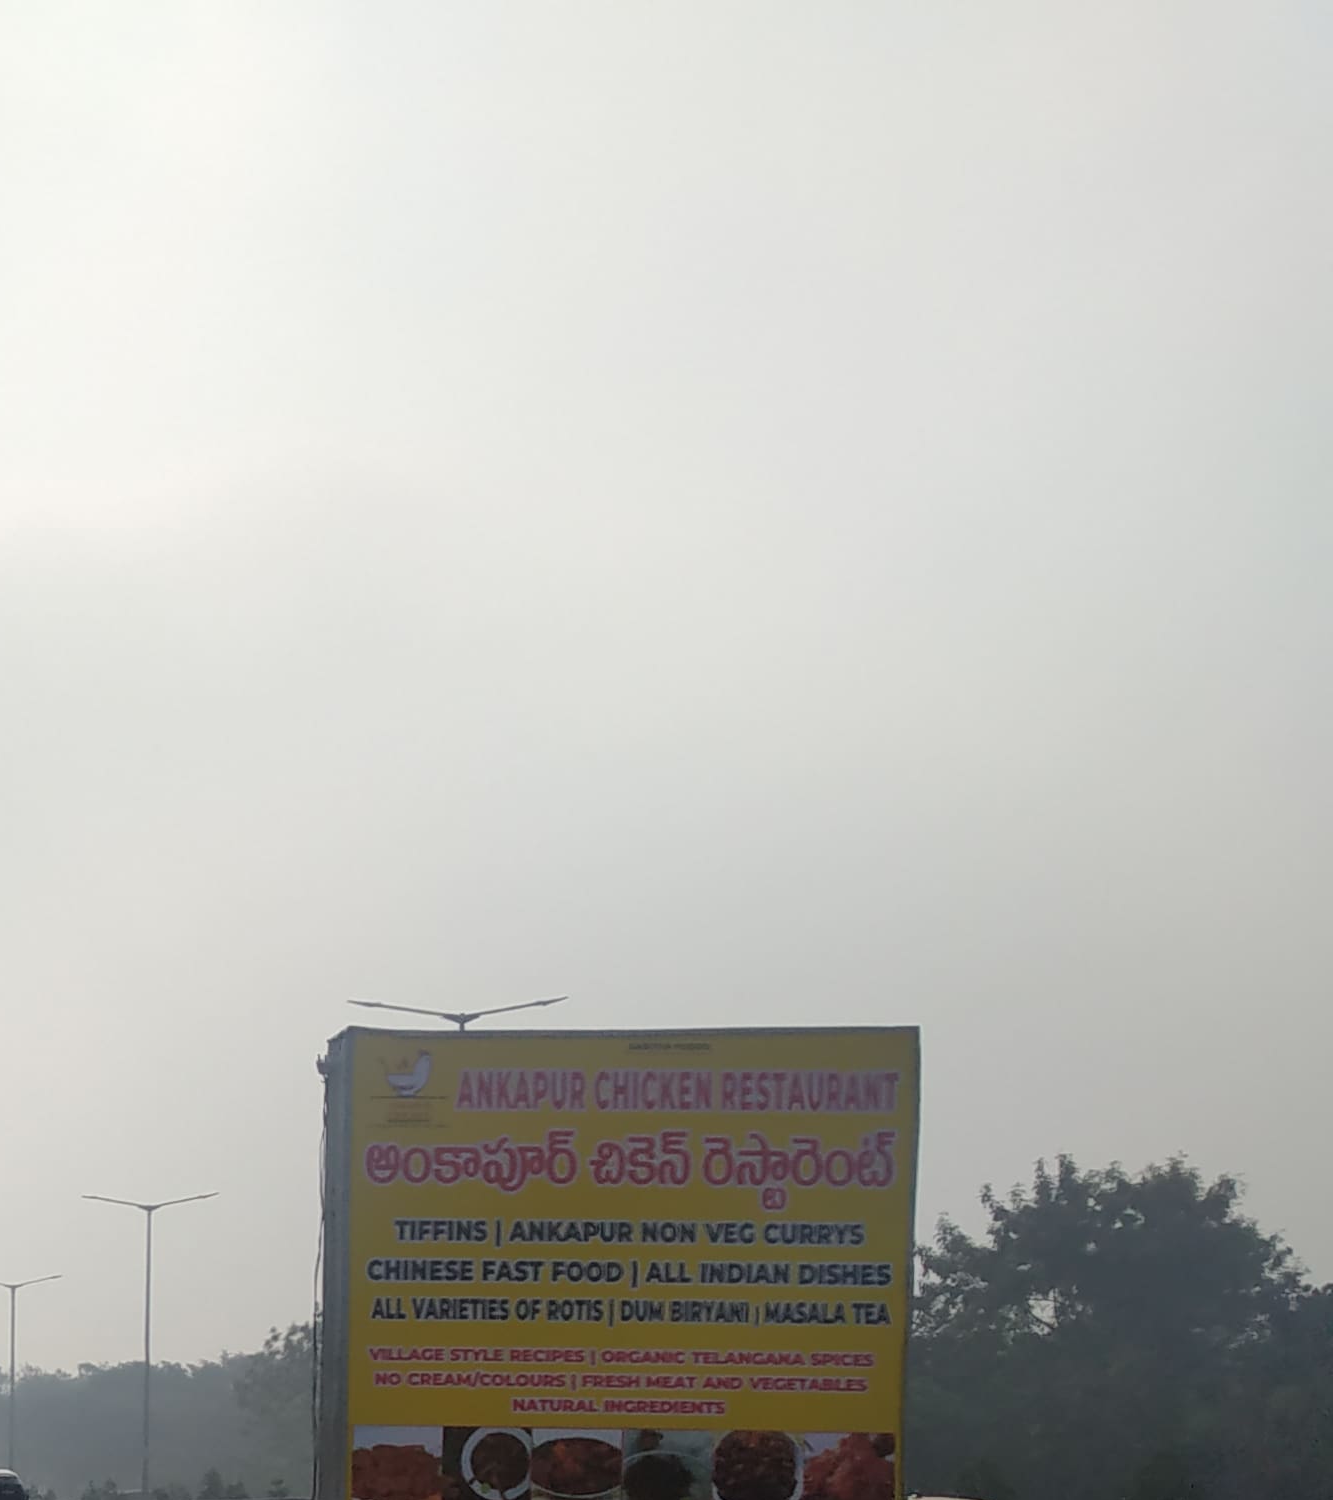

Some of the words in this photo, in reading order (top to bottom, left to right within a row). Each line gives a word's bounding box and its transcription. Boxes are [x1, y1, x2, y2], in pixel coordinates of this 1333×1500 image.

[457, 1071, 585, 1110] ANKAPUR
[594, 1070, 711, 1110] CHICKEN
[721, 1071, 898, 1111] RESTAURANT
[366, 1130, 577, 1191] అంకాపూర్
[590, 1132, 689, 1185] చికెన్
[394, 1219, 487, 1242] TIFFINS
[508, 1220, 633, 1242] ANKAPUR
[641, 1221, 695, 1243] NON
[705, 1222, 754, 1244] VEG
[763, 1223, 864, 1245] CURRYS
[367, 1259, 473, 1281] CHINESE
[481, 1260, 544, 1282] FAST
[551, 1260, 624, 1282] FOOD
[644, 1261, 691, 1283] ALL
[700, 1262, 789, 1284] INDIAN
[798, 1263, 891, 1286] DISHES
[368, 1347, 444, 1361] VILLAGE
[449, 1348, 503, 1362] STYLE
[509, 1348, 585, 1363] RECIPES
[600, 1349, 685, 1364] ORGANIC
[691, 1351, 805, 1365] TELANGANA
[810, 1352, 874, 1367] SPICES
[374, 1372, 401, 1385] NO
[406, 1371, 566, 1387] CREAM/COLOURS
[581, 1374, 640, 1388] FRESH
[645, 1375, 696, 1389] MEAT
[701, 1376, 743, 1390] AND
[748, 1376, 868, 1392] VEGETABLES
[512, 1398, 598, 1412] NATURAL
[603, 1399, 725, 1414] INGREDIENTS
